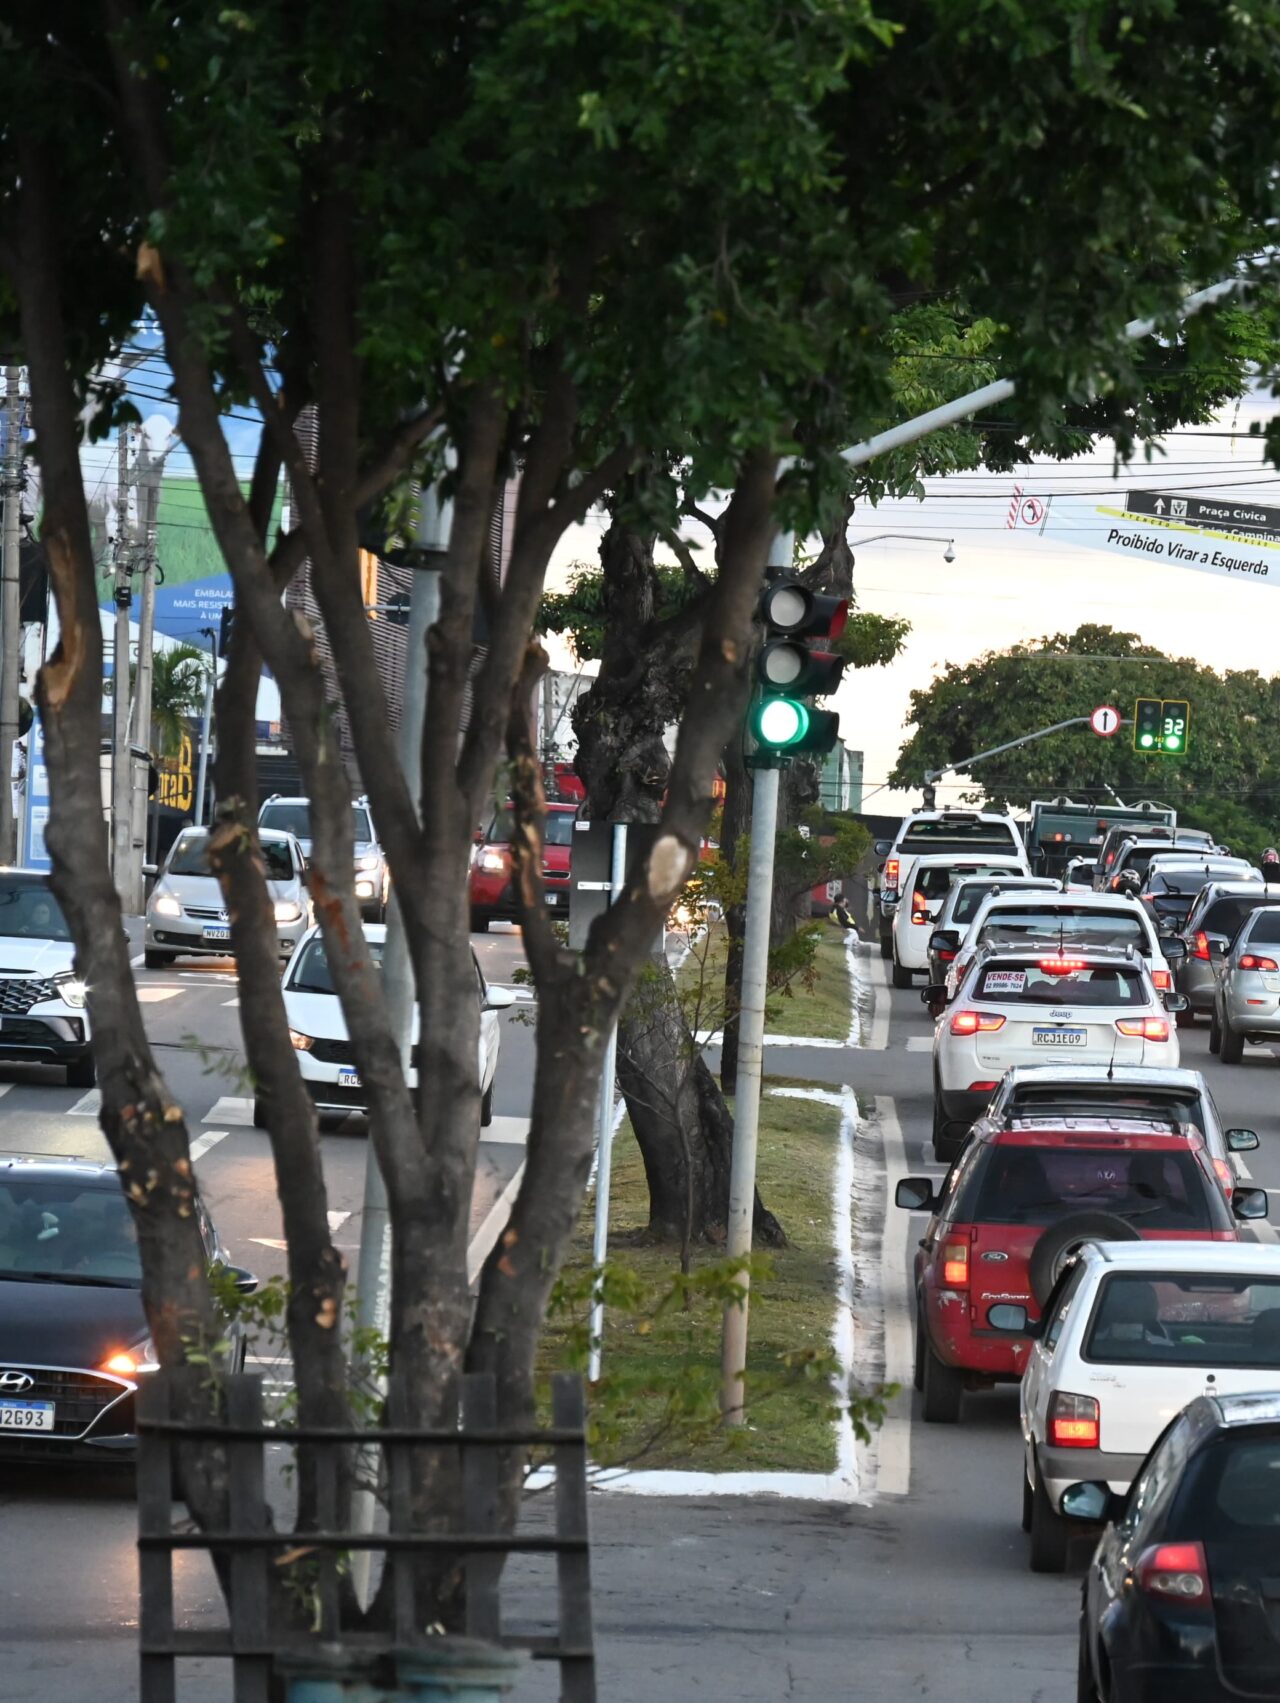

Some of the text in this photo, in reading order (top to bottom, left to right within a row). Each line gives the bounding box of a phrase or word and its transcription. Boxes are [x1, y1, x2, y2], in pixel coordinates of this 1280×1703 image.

[1199, 505, 1267, 522] Praça Cívica
[1107, 529, 1269, 576] Proibido Virar a Esquerda
[173, 600, 197, 608] MAIS
[1164, 718, 1184, 735] 32
[987, 972, 1025, 982] VENDE-SE
